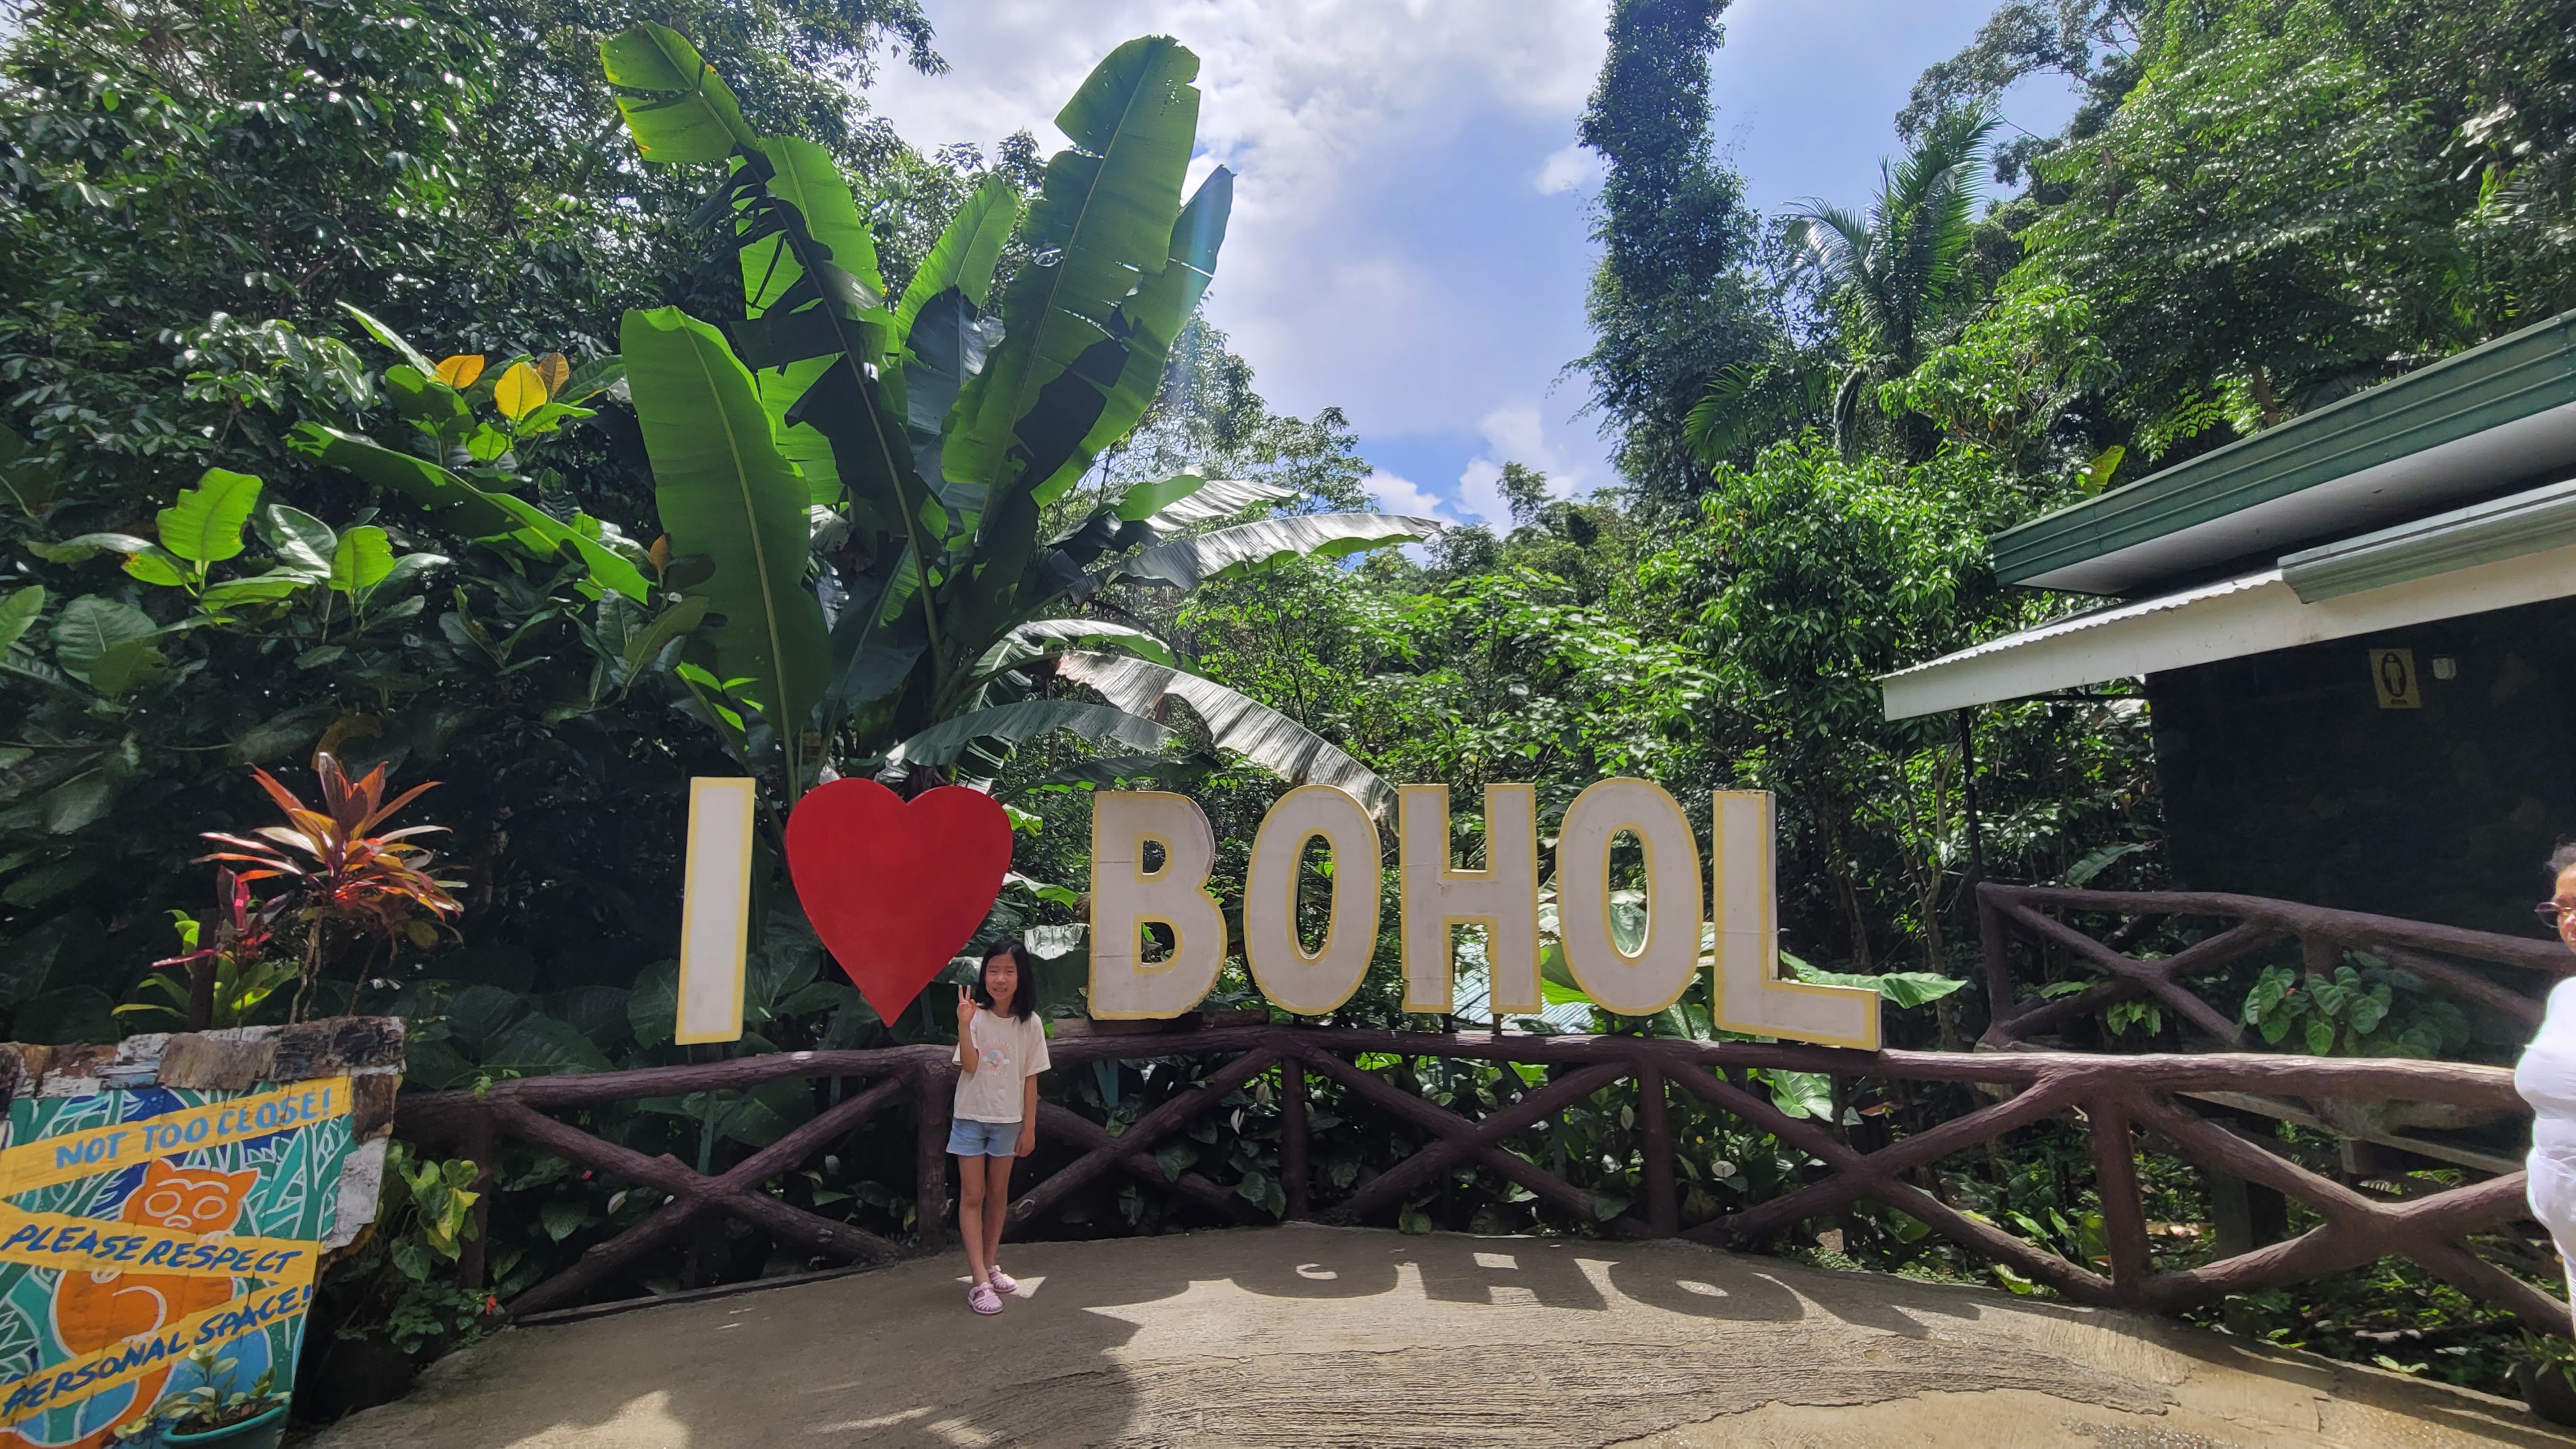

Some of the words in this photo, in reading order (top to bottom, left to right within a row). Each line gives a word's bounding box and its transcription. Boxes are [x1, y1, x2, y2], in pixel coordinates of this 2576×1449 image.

[675, 777, 756, 1045] I
[1087, 776, 1882, 1052] BOHOL
[56, 1131, 128, 1169] NOT
[142, 1116, 209, 1153] TOO
[217, 1087, 331, 1135] CLOSE!
[0, 1224, 148, 1261] PLEASE
[139, 1239, 303, 1273] RESPECT
[2, 1331, 189, 1417] PERSONAL
[194, 1284, 312, 1346] SPACE!
